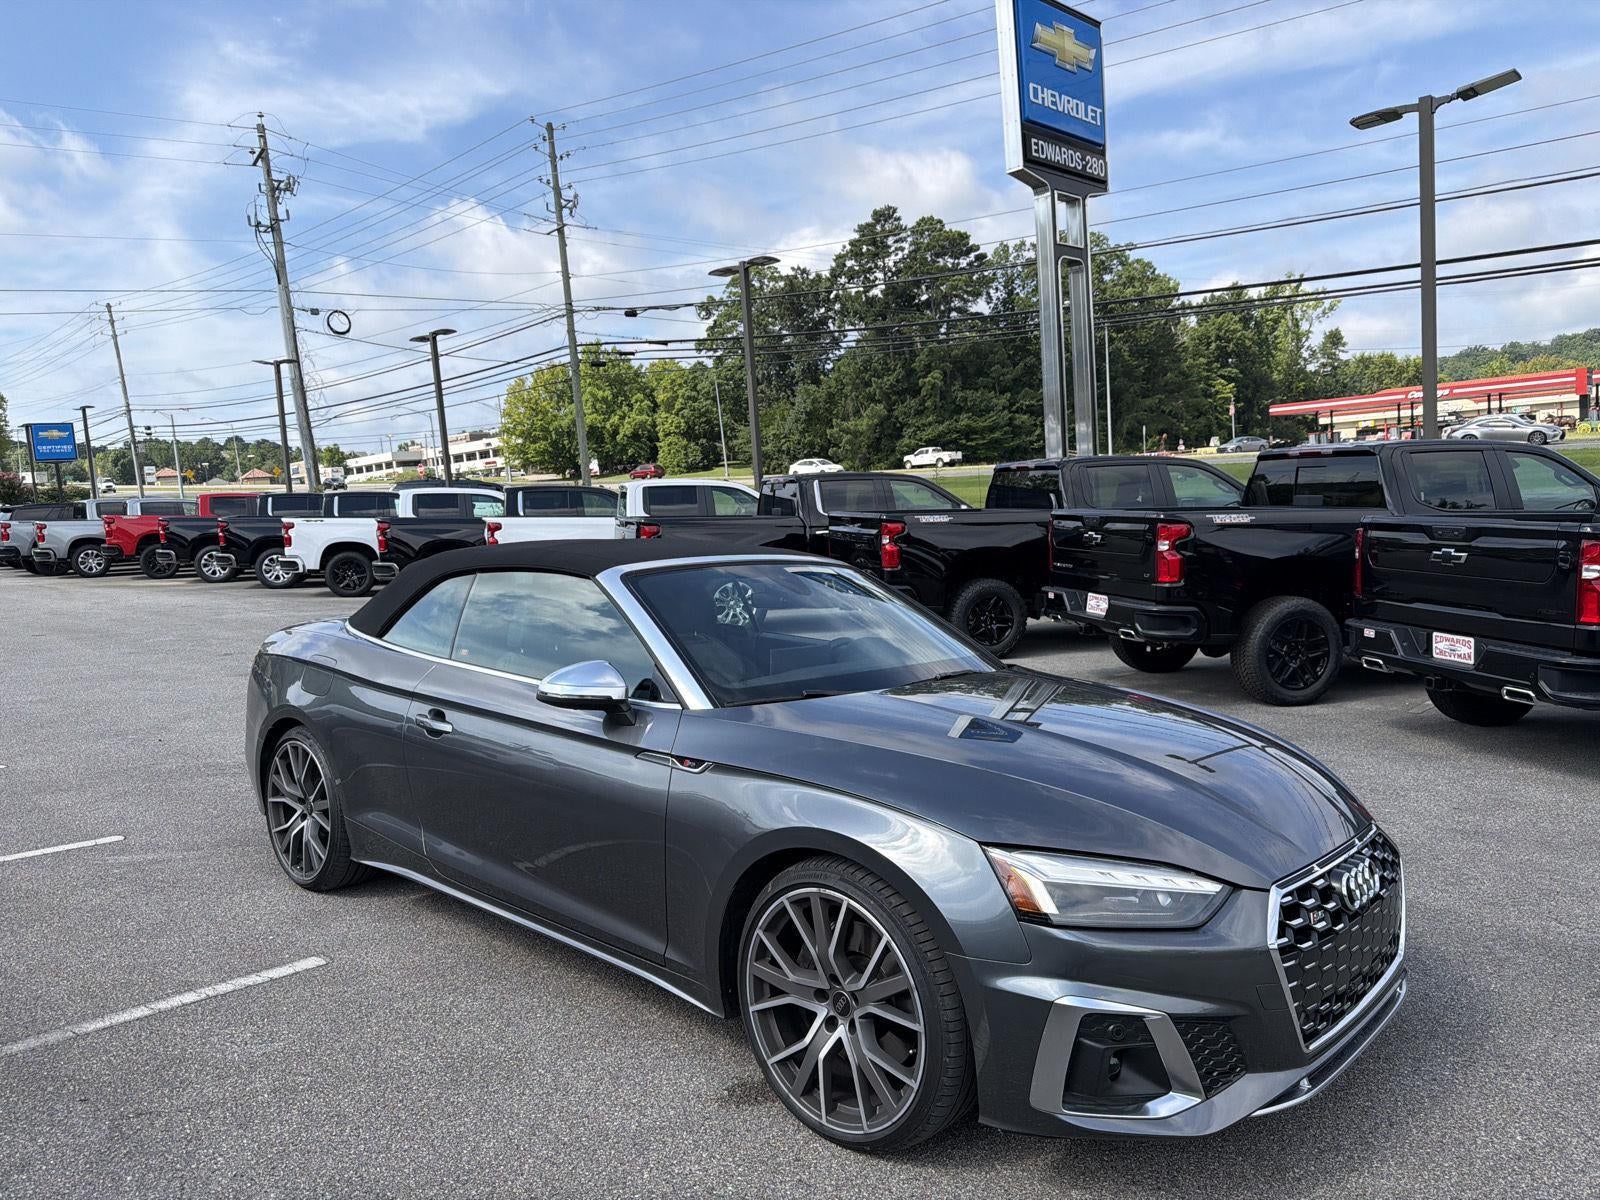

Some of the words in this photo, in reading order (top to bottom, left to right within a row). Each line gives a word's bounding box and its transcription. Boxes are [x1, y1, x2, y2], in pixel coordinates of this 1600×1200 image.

[1029, 82, 1102, 126] CHEVROLET
[1031, 137, 1105, 177] EDWARDS-280
[1434, 635, 1472, 650] EDWARDS
[1434, 646, 1472, 662] CHEVYMAN
